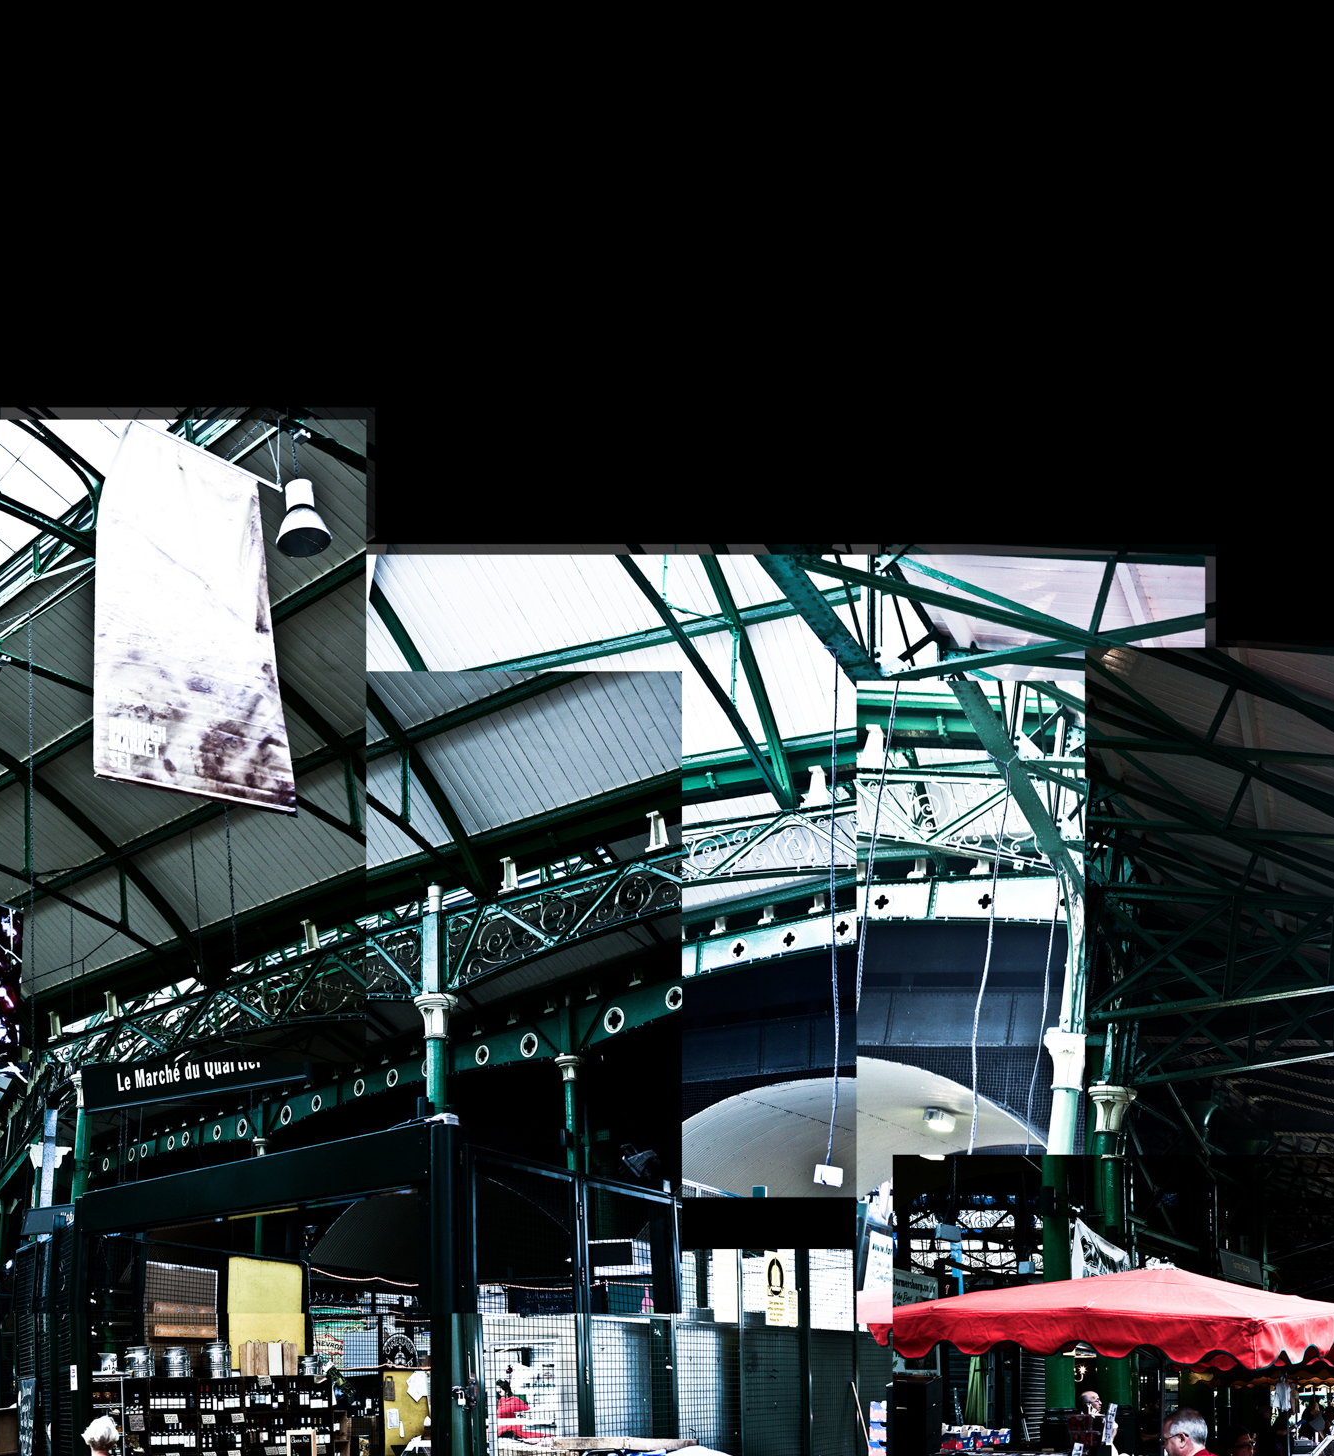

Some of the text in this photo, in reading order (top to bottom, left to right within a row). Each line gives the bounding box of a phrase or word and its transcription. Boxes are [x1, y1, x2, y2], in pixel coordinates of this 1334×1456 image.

[117, 1073, 131, 1092] Le
[134, 1063, 180, 1089] Marché
[185, 1062, 200, 1080] du
